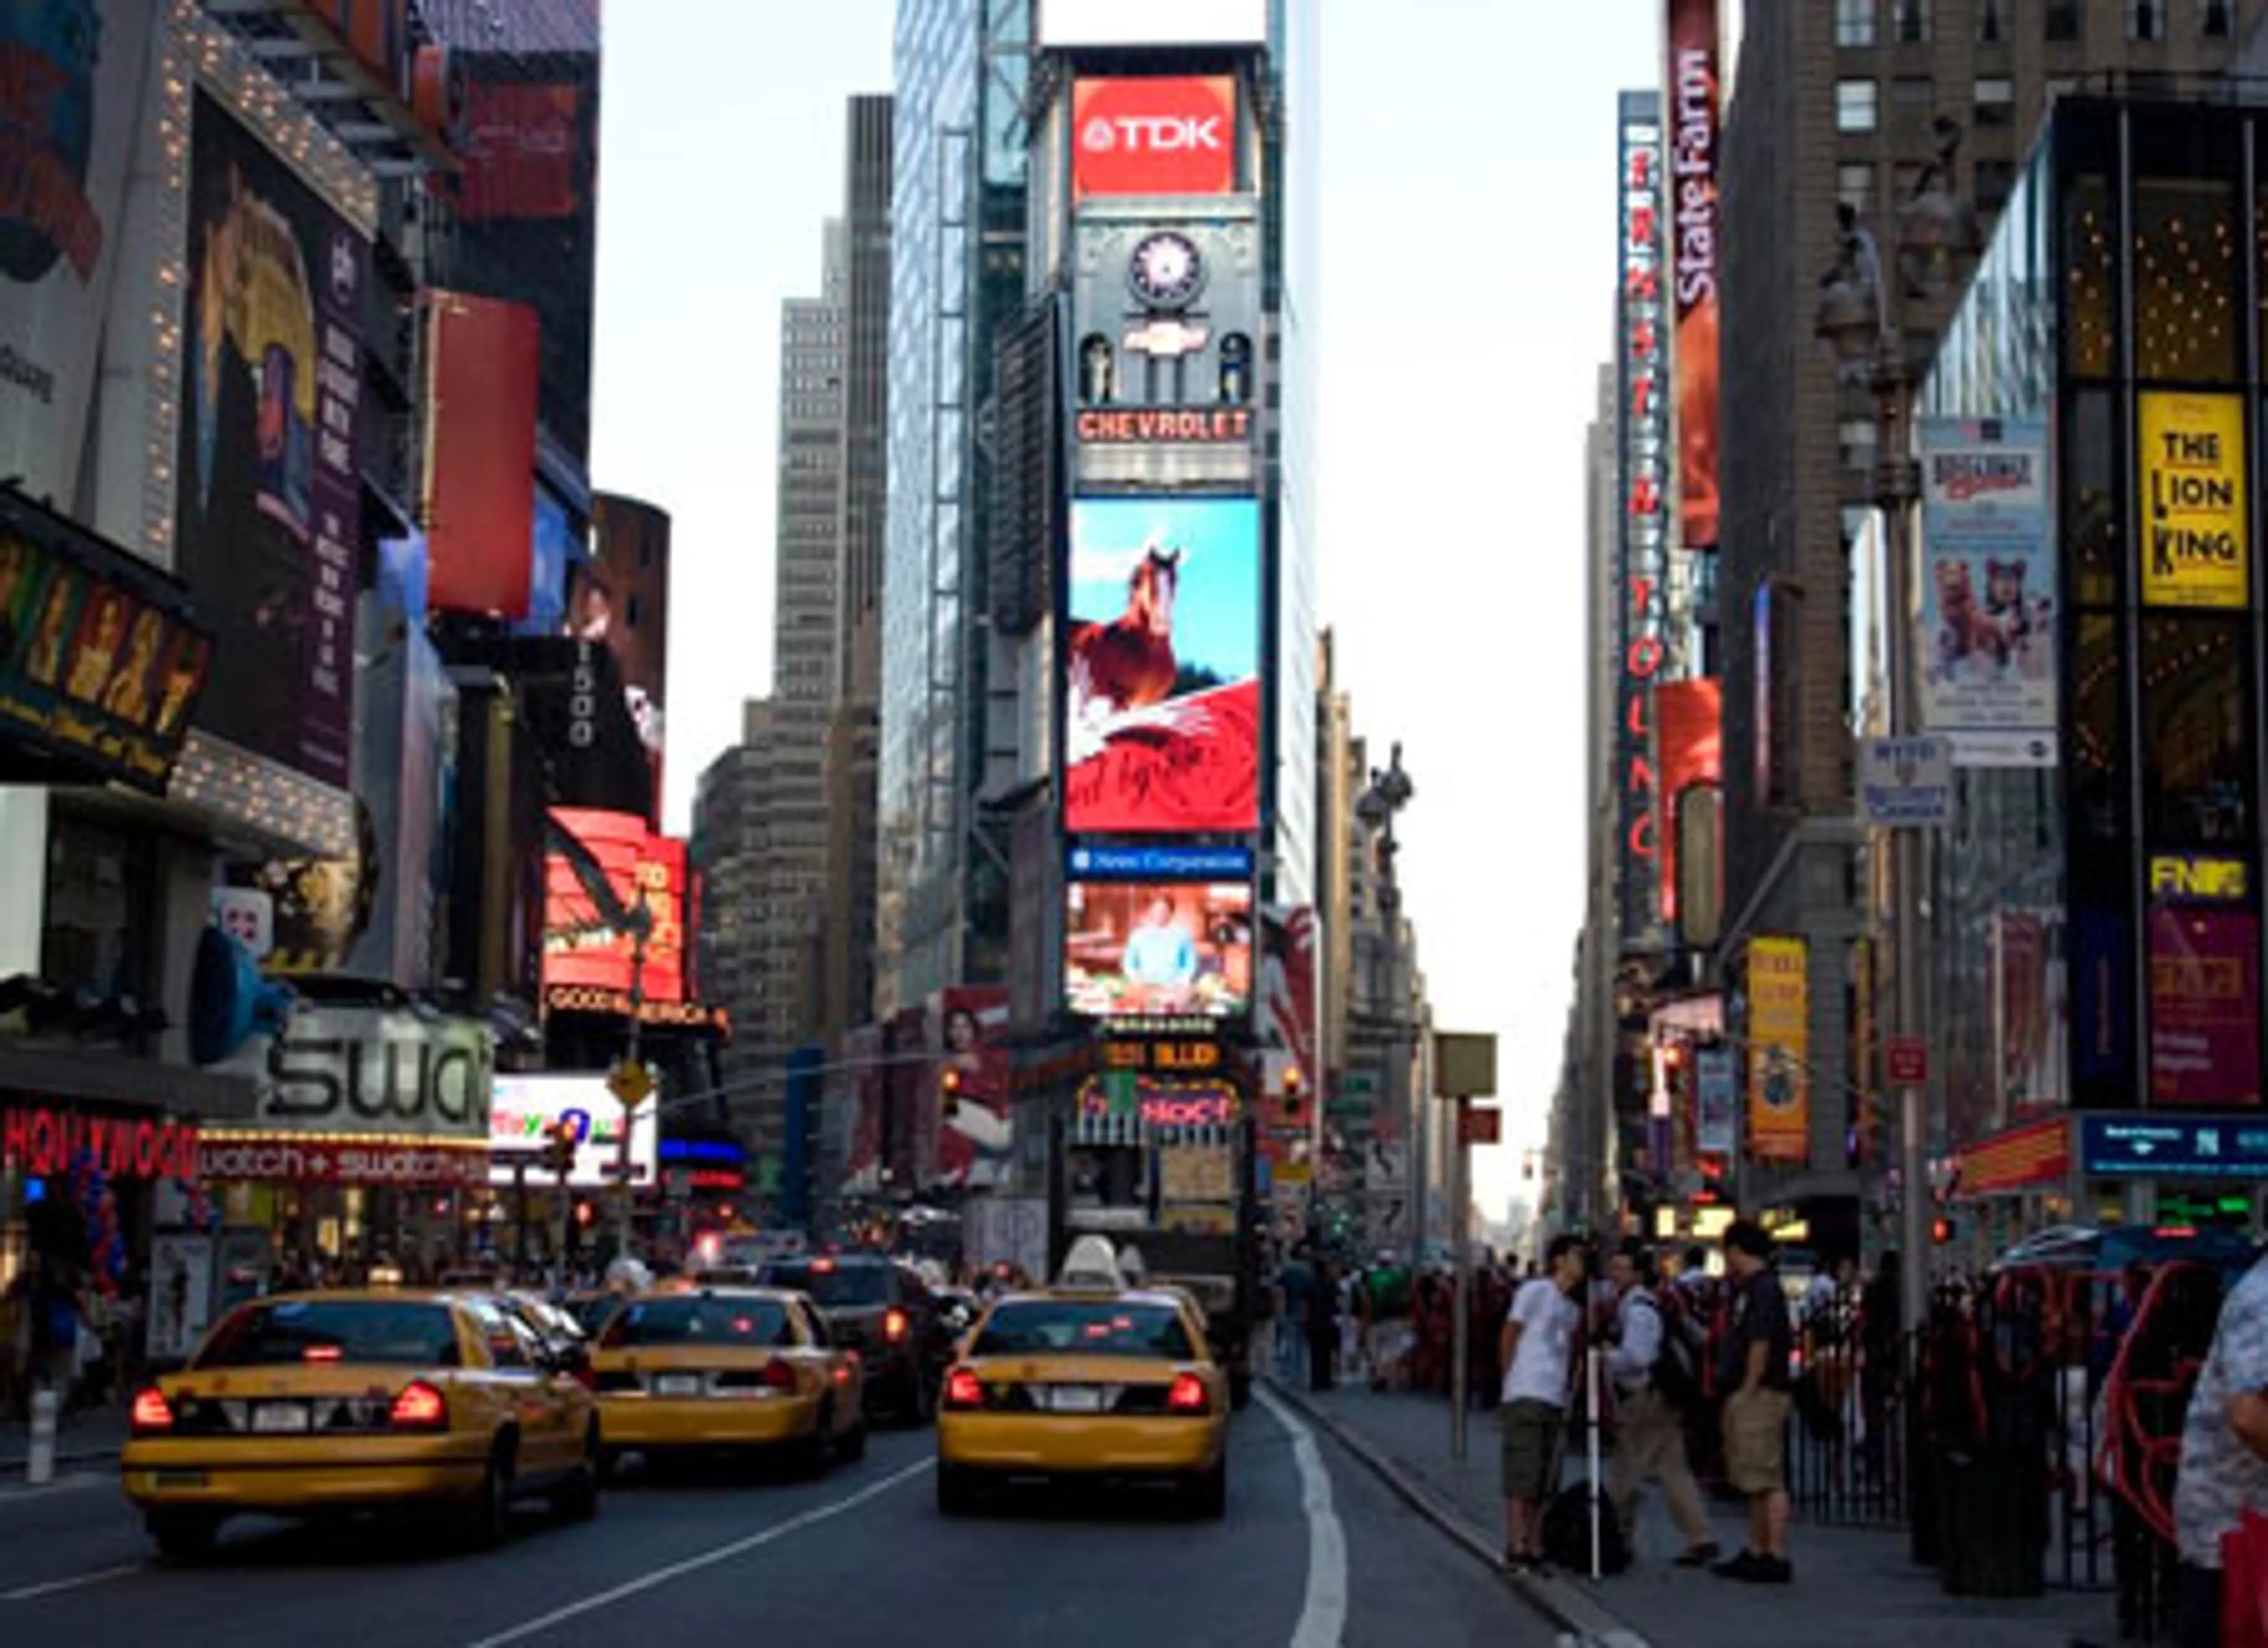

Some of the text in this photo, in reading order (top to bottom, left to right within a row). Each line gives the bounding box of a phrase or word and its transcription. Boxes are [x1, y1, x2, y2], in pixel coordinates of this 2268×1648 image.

[1120, 115, 1220, 151] TDK
[1673, 50, 1714, 304] State Farm
[1077, 411, 1249, 441] CHEVROLET
[2161, 431, 2220, 461] THE
[2151, 468, 2234, 520] LION
[2152, 523, 2238, 577] KING
